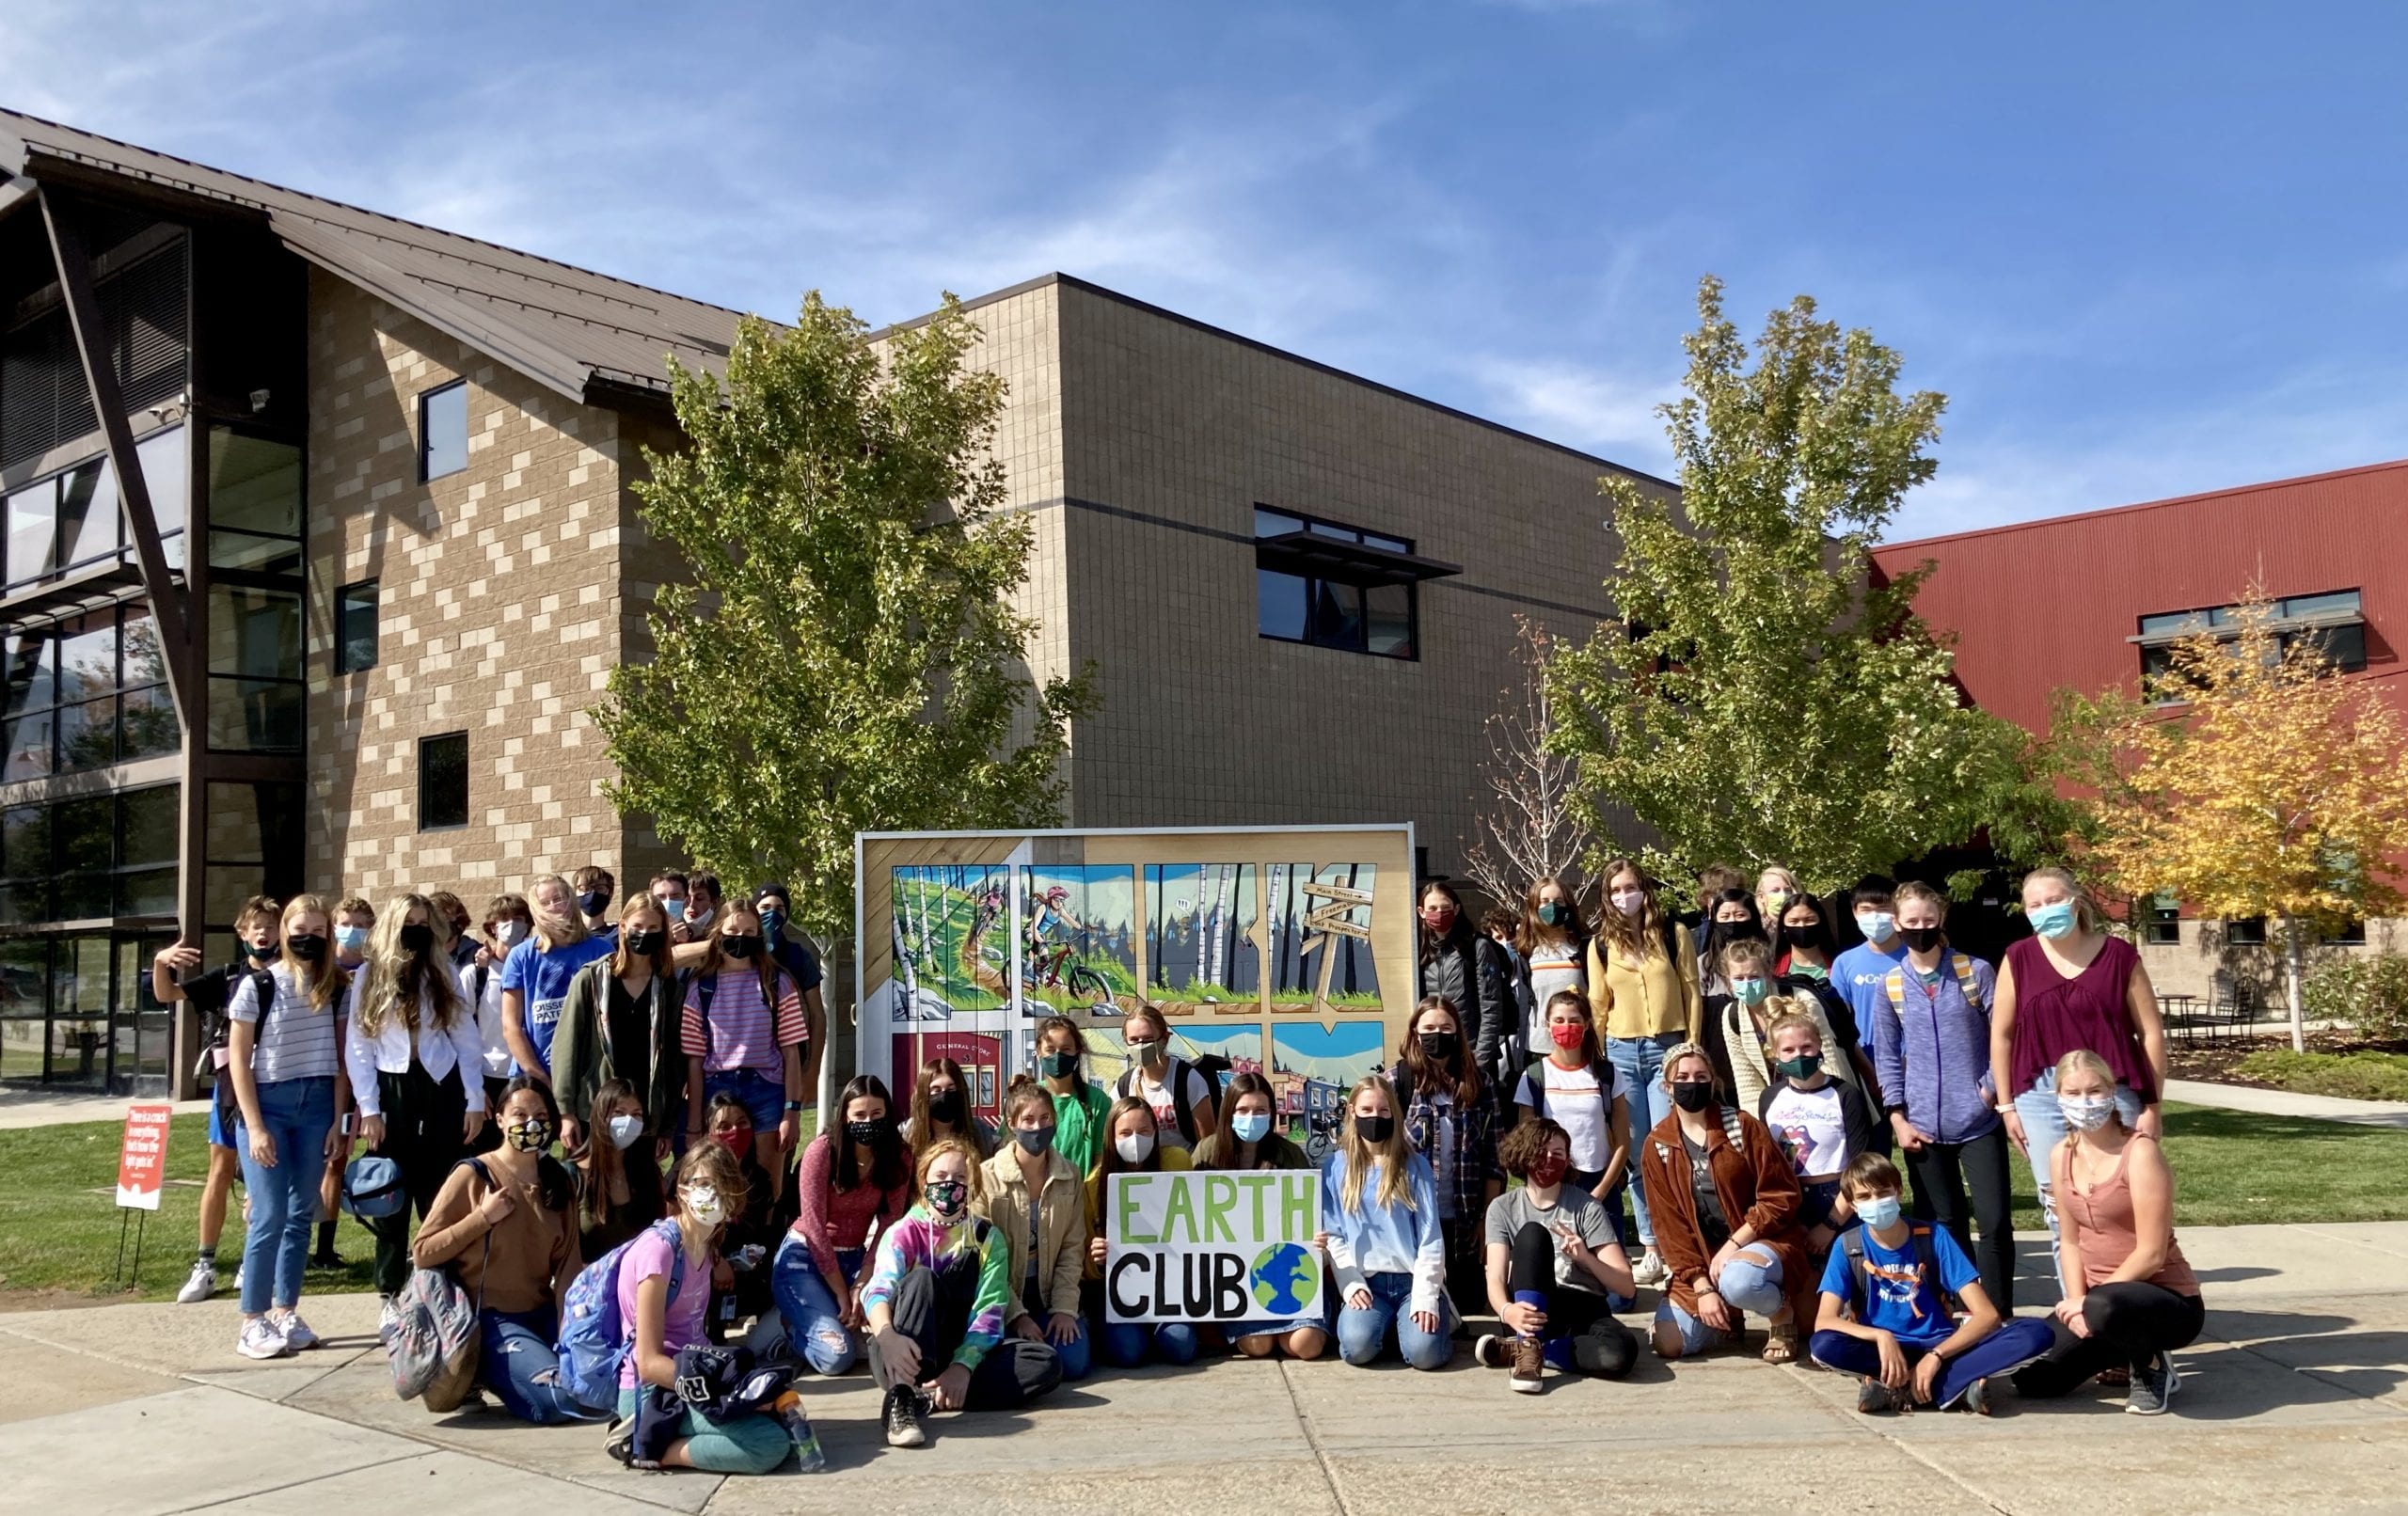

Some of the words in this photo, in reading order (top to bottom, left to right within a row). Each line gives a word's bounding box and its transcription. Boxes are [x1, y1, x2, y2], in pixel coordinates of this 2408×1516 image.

[1316, 887, 1332, 895] Main
[1334, 889, 1353, 898] Street
[971, 1045, 991, 1057] STORE
[1118, 1176, 1315, 1244] EARTH
[1109, 1253, 1248, 1319] CLUB
